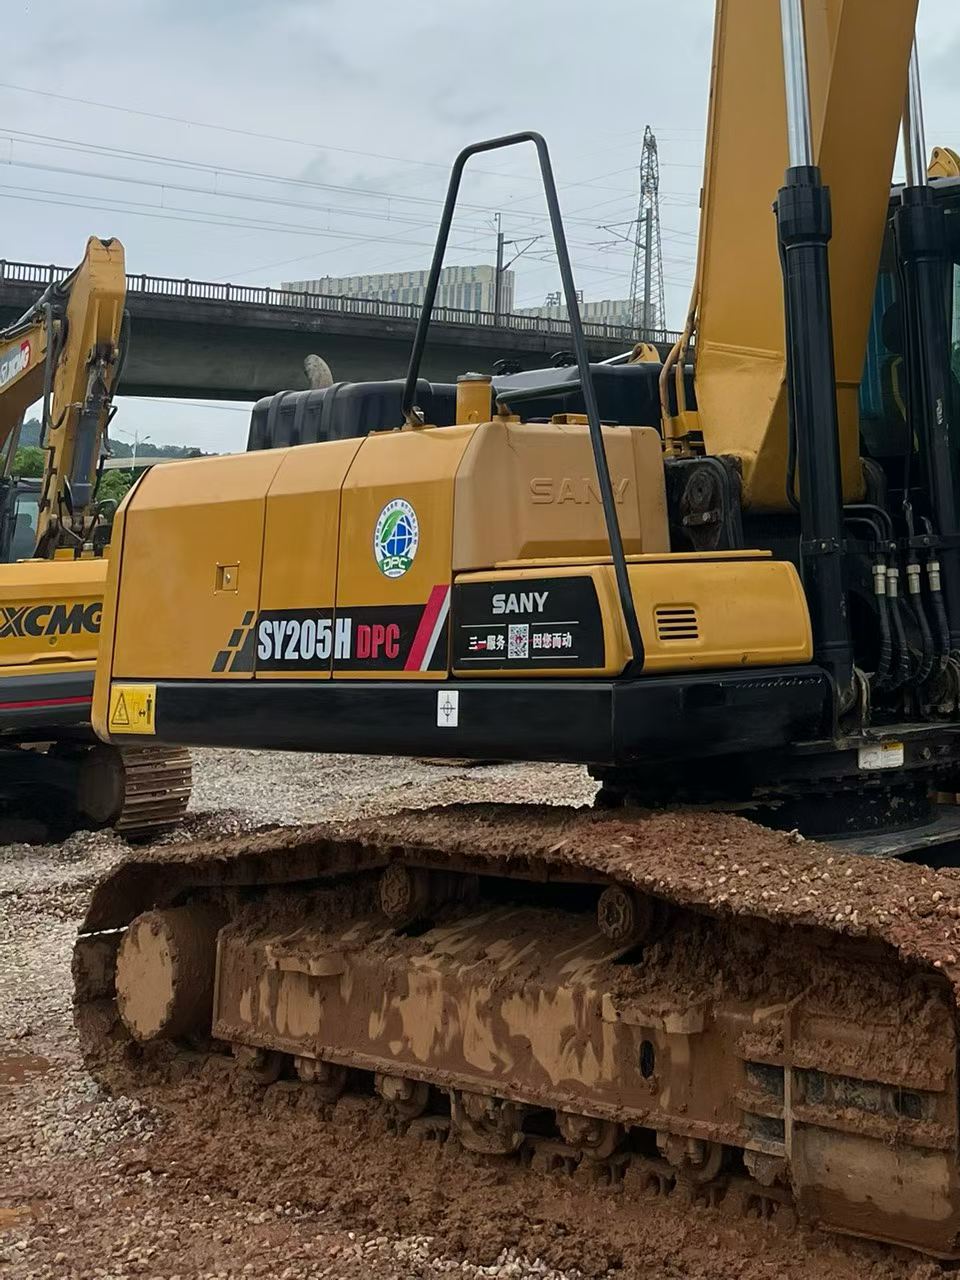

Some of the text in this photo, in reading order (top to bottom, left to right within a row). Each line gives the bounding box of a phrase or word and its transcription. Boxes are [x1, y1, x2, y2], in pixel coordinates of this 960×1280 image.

[529, 477, 630, 505] SANY
[383, 557, 408, 571] DPC
[492, 592, 550, 614] SANY
[0, 602, 103, 637] XCMG
[257, 618, 400, 660] SY205H DPC
[469, 632, 573, 650] 三一服务 因您而动
